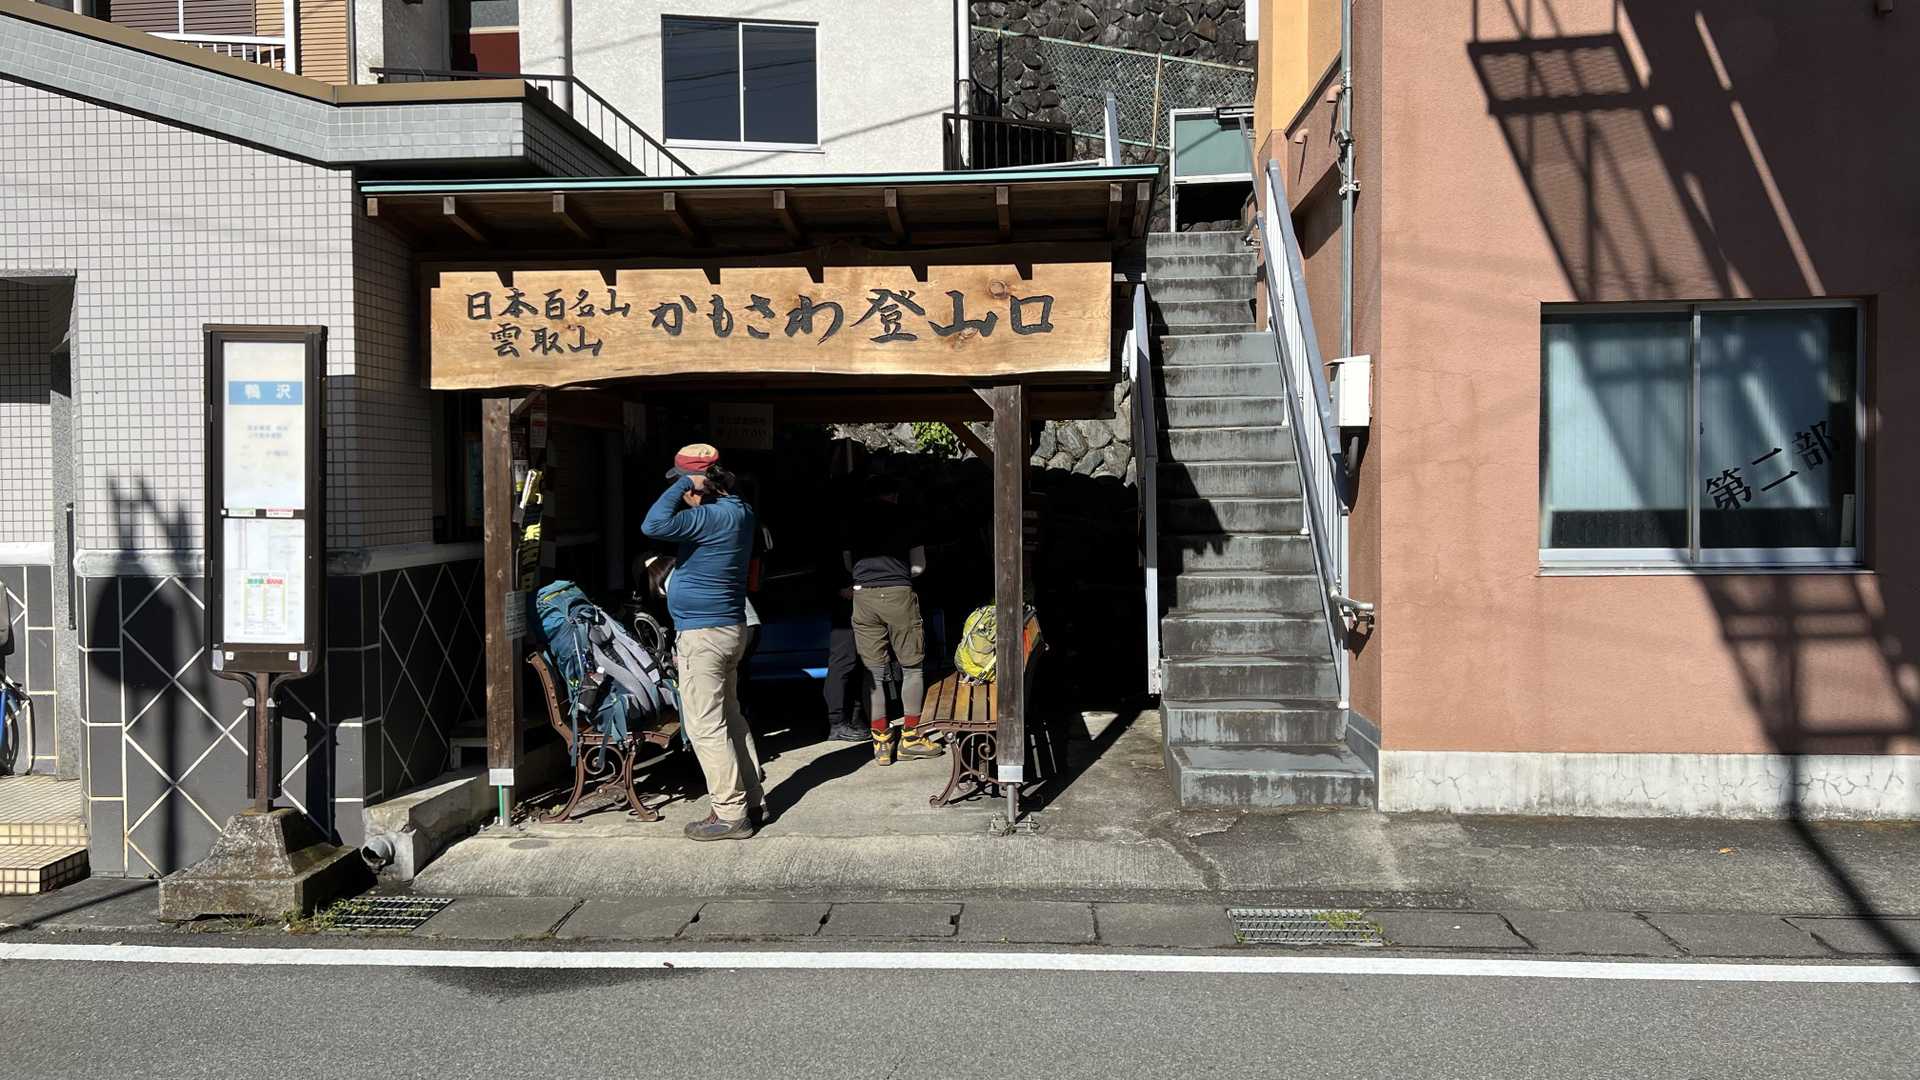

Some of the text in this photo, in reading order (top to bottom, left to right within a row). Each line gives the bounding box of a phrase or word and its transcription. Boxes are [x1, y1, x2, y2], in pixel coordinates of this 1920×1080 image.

[466, 288, 630, 320] 日本百名山
[649, 288, 1054, 345] かもさわ登山口
[489, 323, 603, 358] 雲取山
[1706, 420, 1839, 510] 第二部
